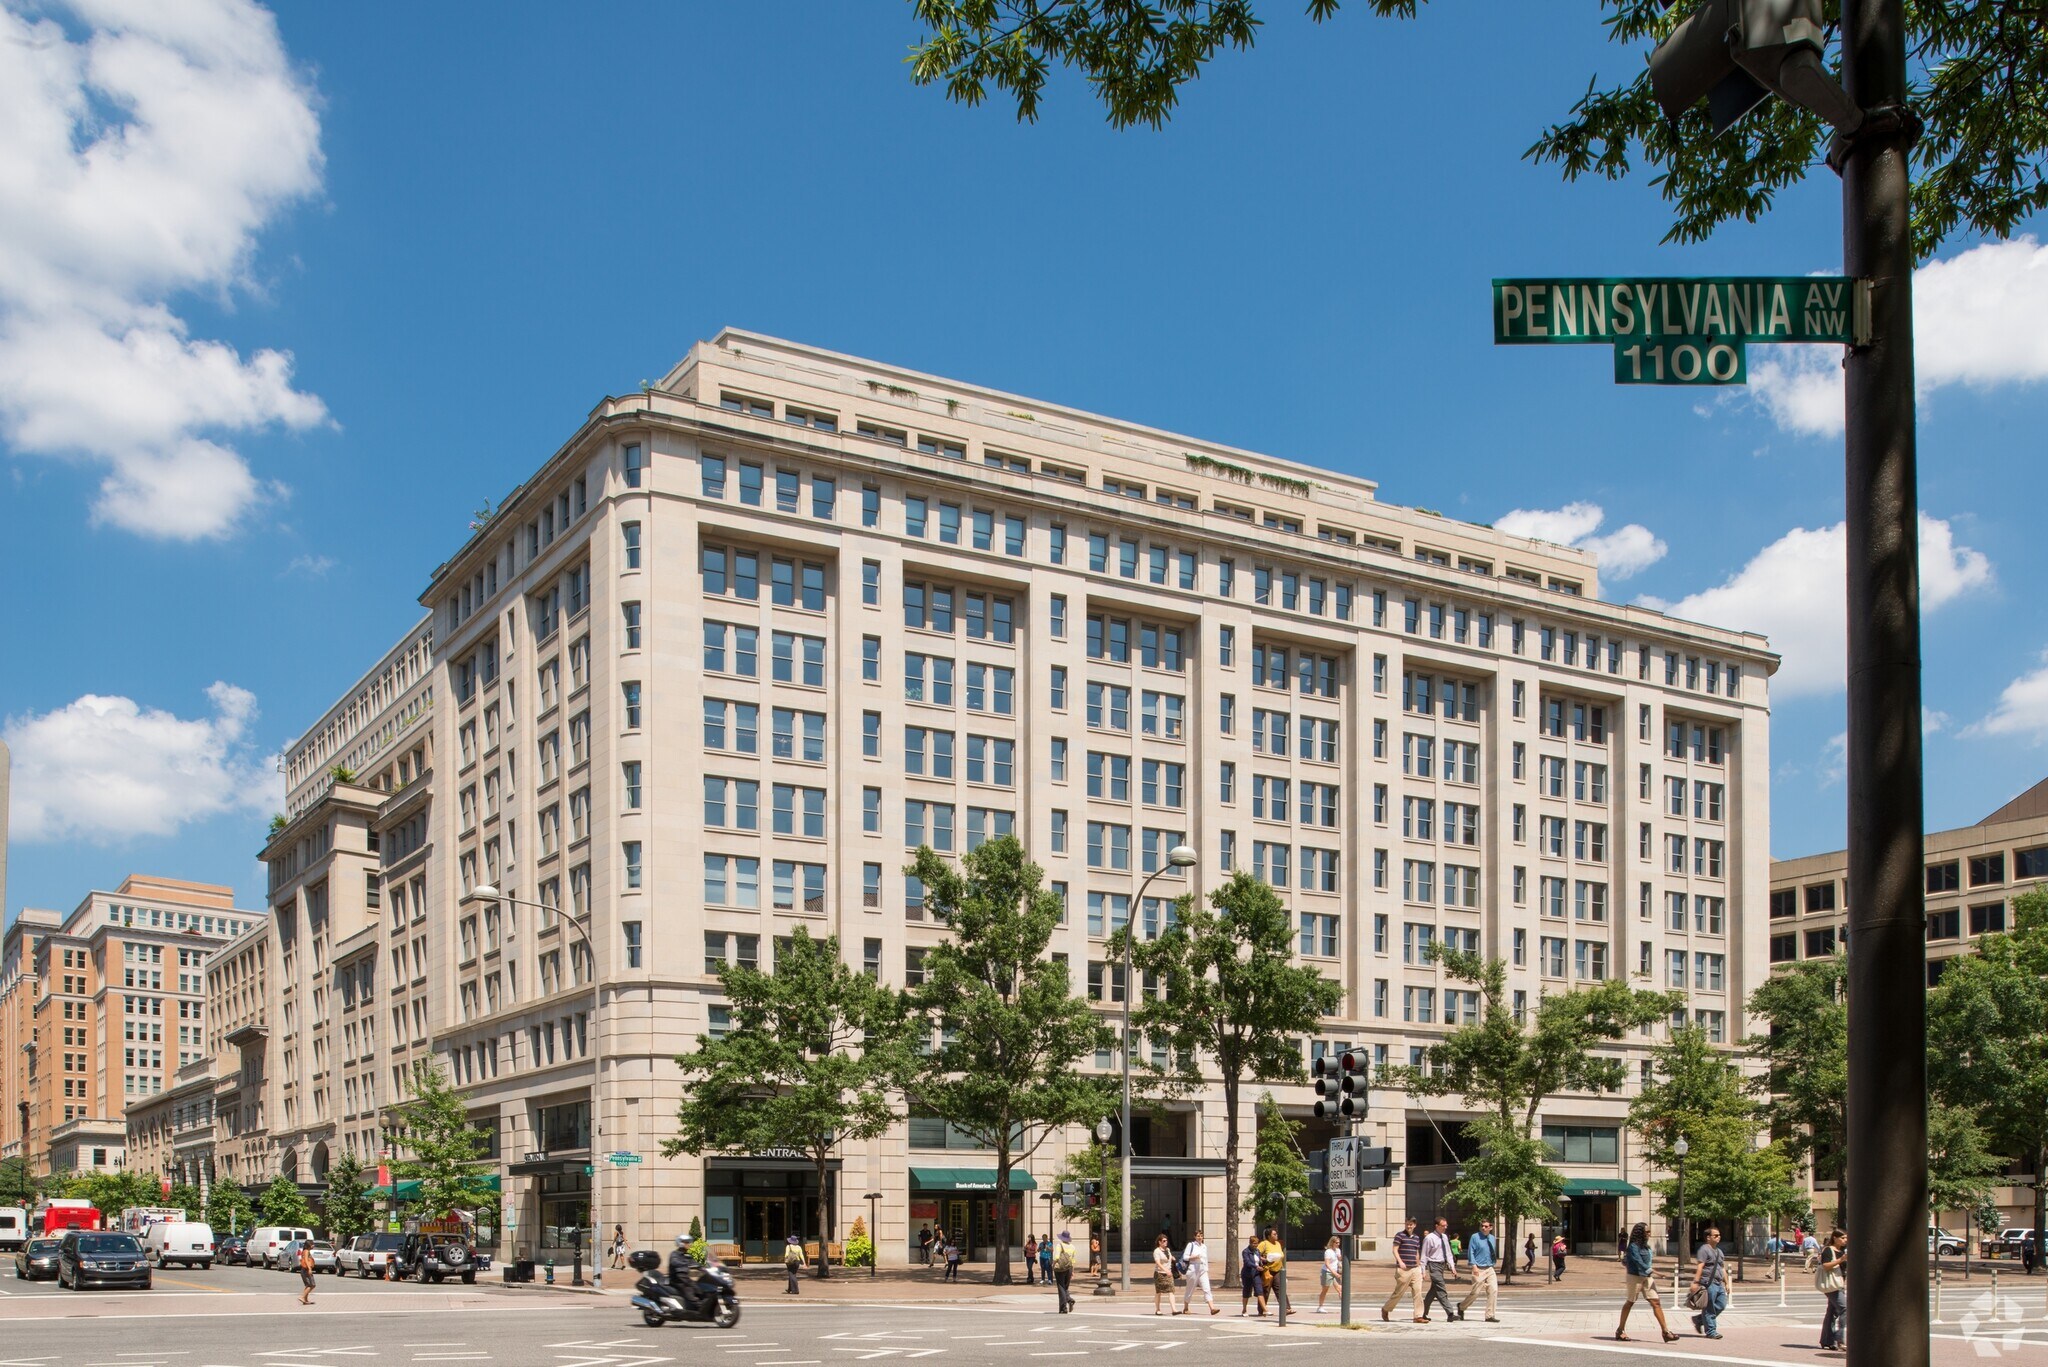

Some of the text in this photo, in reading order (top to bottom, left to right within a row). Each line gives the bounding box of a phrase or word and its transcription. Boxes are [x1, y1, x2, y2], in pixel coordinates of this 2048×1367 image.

[1501, 282, 1844, 337] PENNSYLVANIA AV
[1803, 310, 1846, 336] NW
[1622, 344, 1739, 381] 1100
[1331, 1141, 1344, 1151] THRU
[1330, 1169, 1355, 1179] OBEY THIS
[1330, 1181, 1348, 1190] SIGNAL
[143, 1215, 182, 1226] FedE
